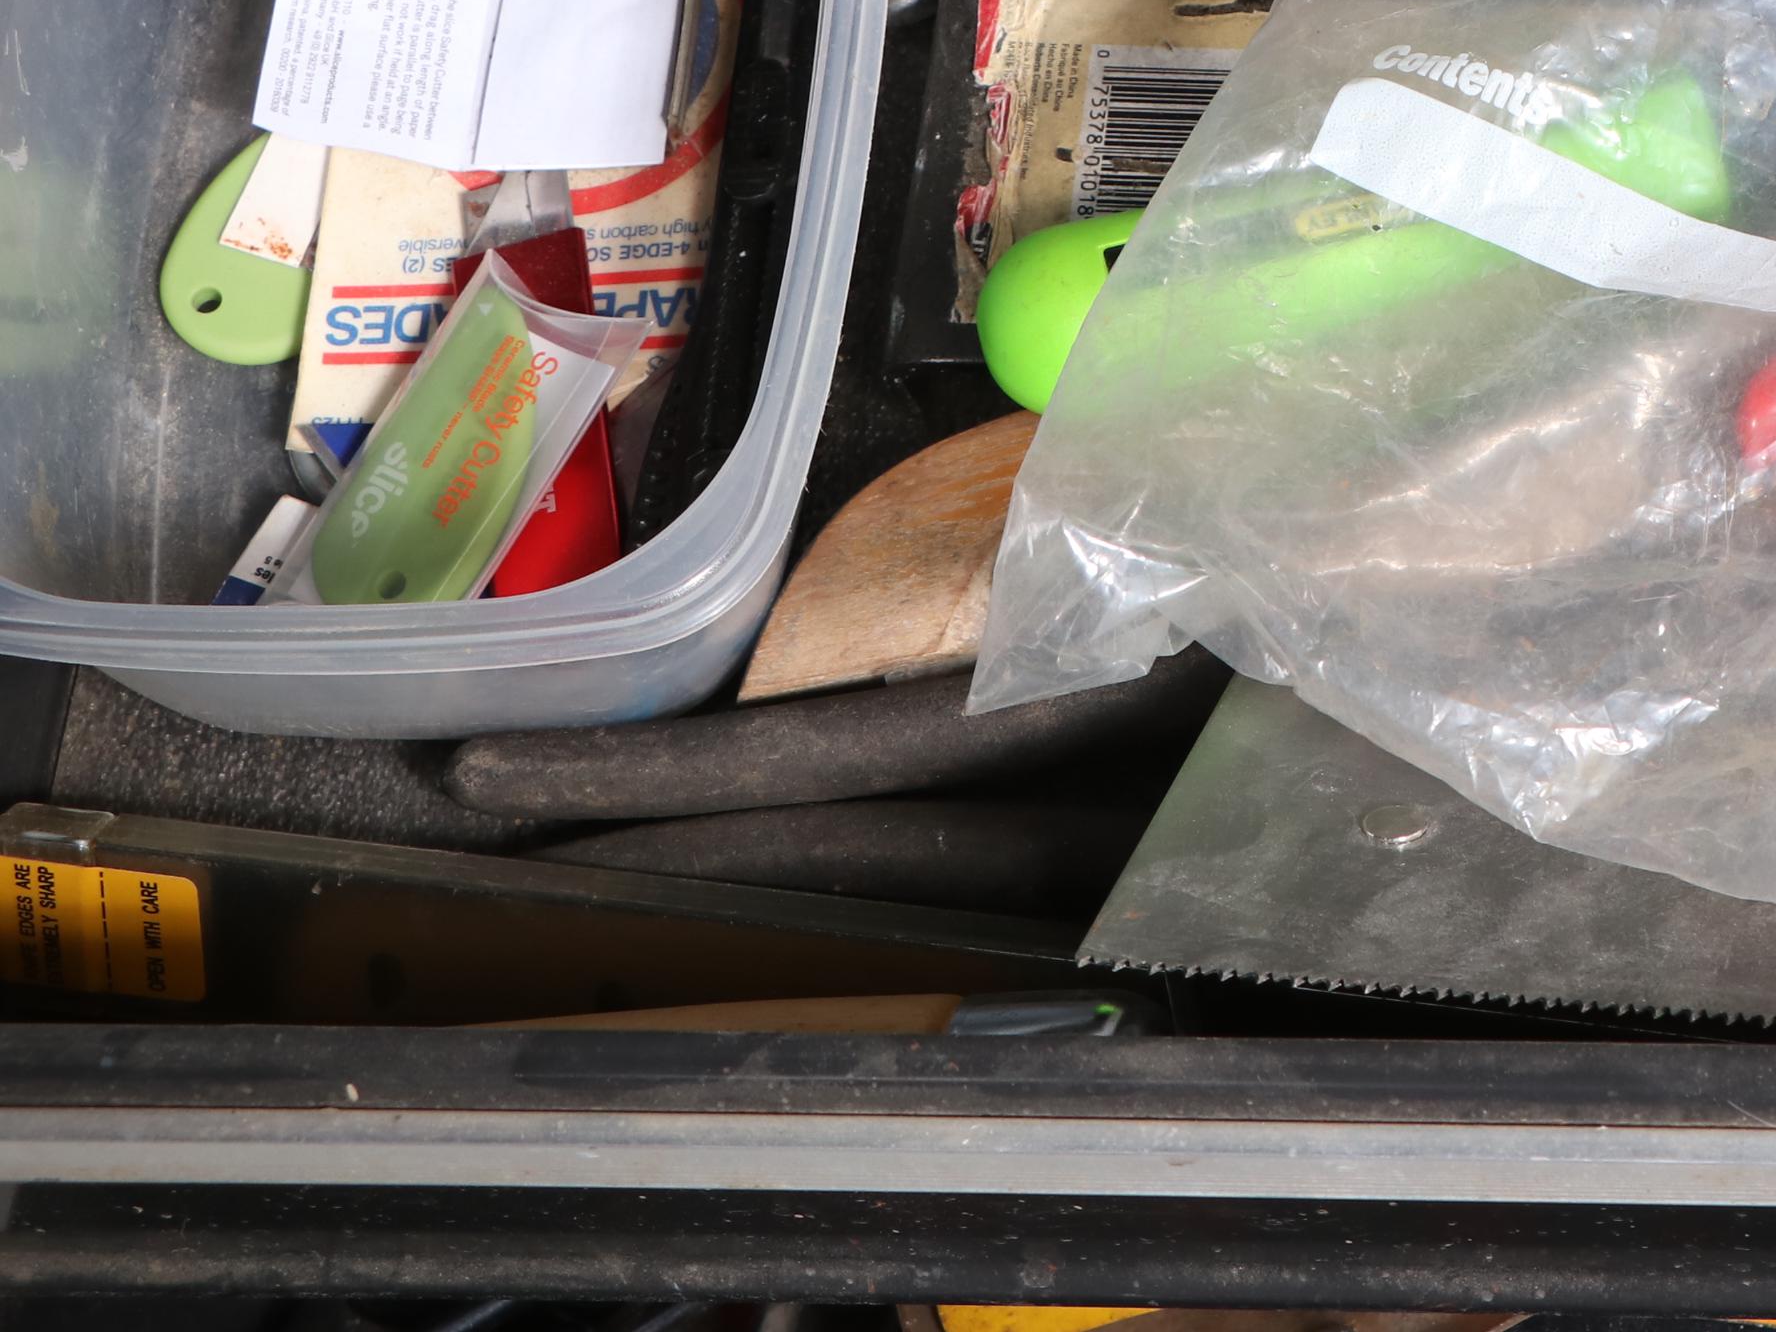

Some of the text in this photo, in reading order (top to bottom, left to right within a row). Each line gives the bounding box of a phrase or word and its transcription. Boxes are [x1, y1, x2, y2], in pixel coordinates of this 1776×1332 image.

[1072, 43, 1083, 65] Made
[1097, 49, 1110, 59] 0
[1067, 75, 1078, 99] China
[1372, 42, 1556, 127] Contents
[1086, 85, 1110, 145] 75378
[601, 224, 658, 240] carbon
[662, 218, 698, 237] high
[618, 241, 690, 260] 4-EDGE
[402, 256, 425, 273] (2)
[432, 351, 558, 529] Safety Cutter
[351, 441, 409, 538] slice
[14, 864, 31, 890] ARE
[37, 866, 57, 909] SHARP
[17, 895, 36, 937] EDGES
[139, 880, 166, 991] OPEN WITH CARE
